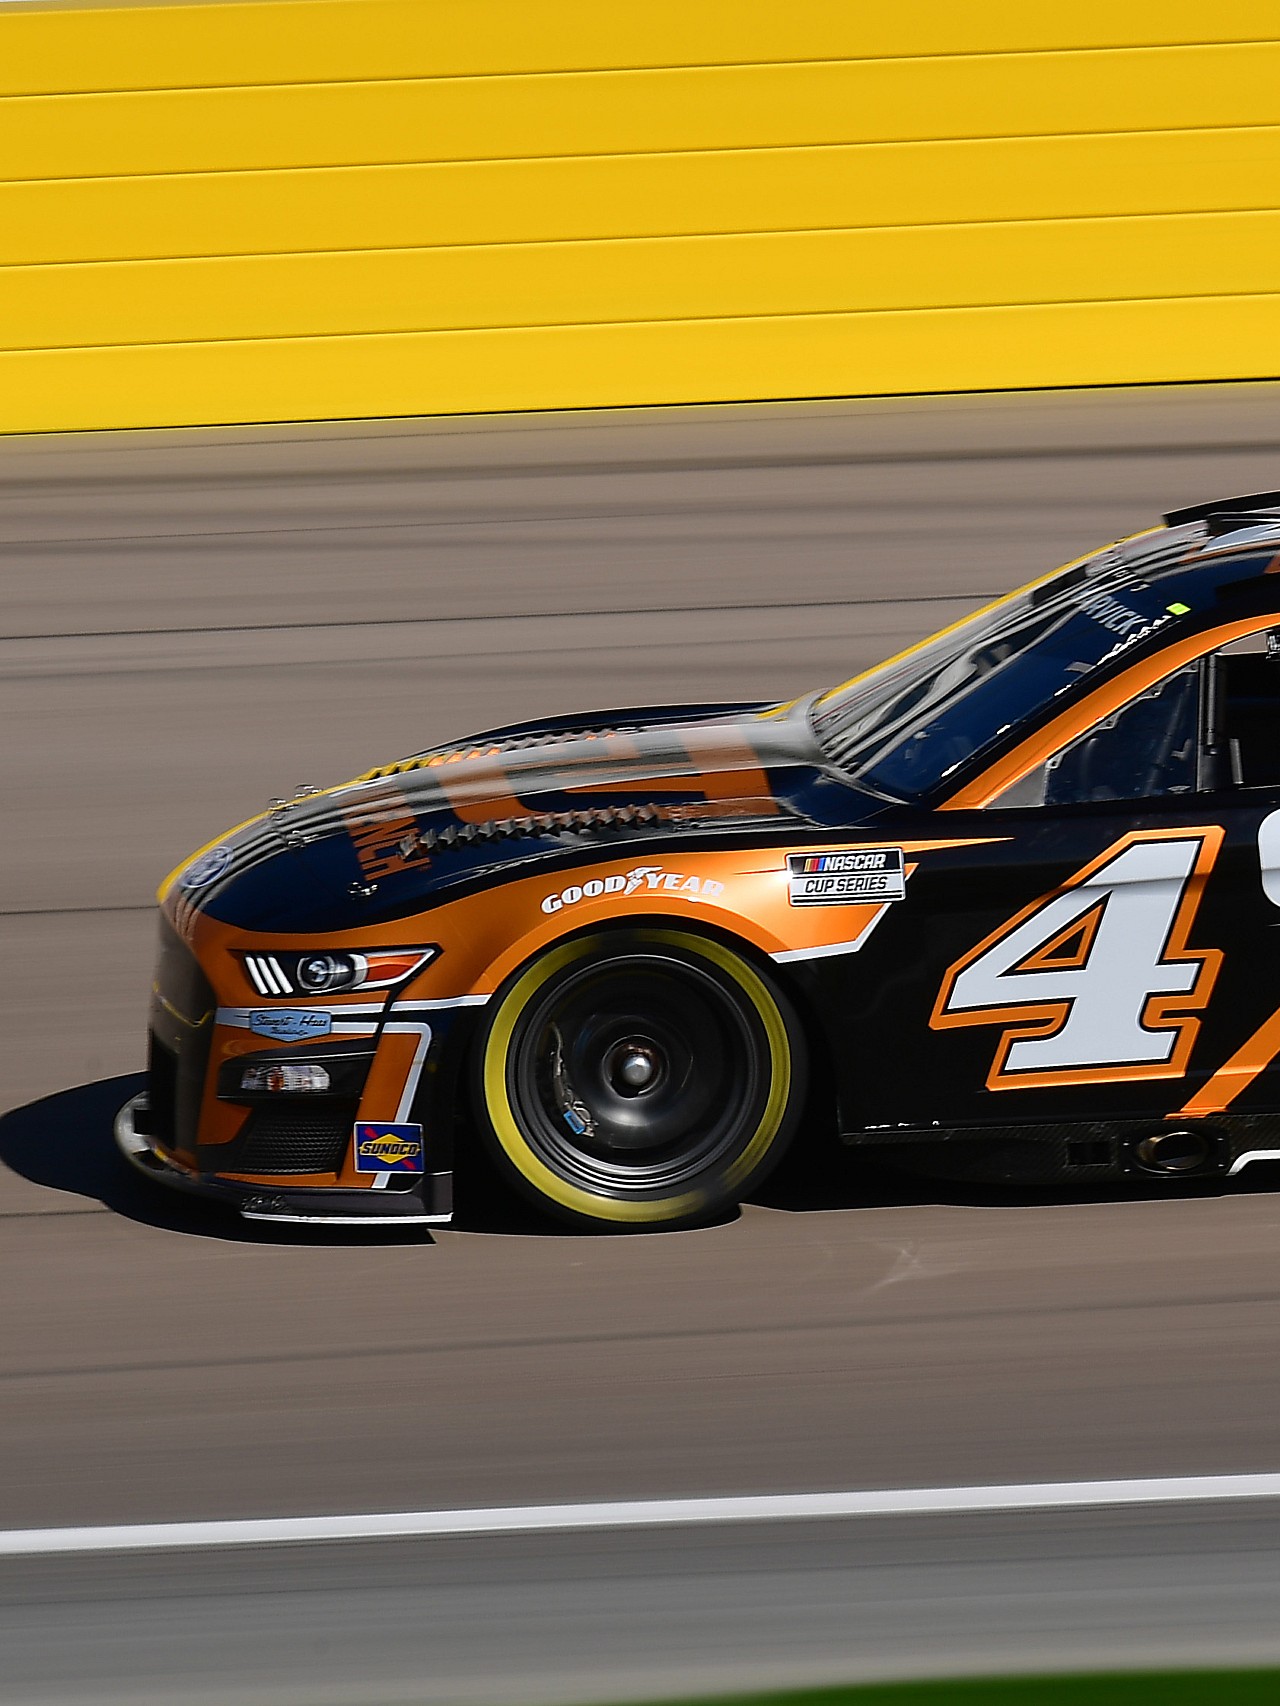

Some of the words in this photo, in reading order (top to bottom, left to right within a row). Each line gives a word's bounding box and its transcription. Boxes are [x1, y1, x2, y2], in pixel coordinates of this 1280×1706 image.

[823, 853, 887, 871] NASCAR
[805, 879, 835, 893] CUP
[836, 876, 888, 892] SERIES
[929, 826, 1225, 1091] 4
[361, 1142, 418, 1155] SUNOCO
